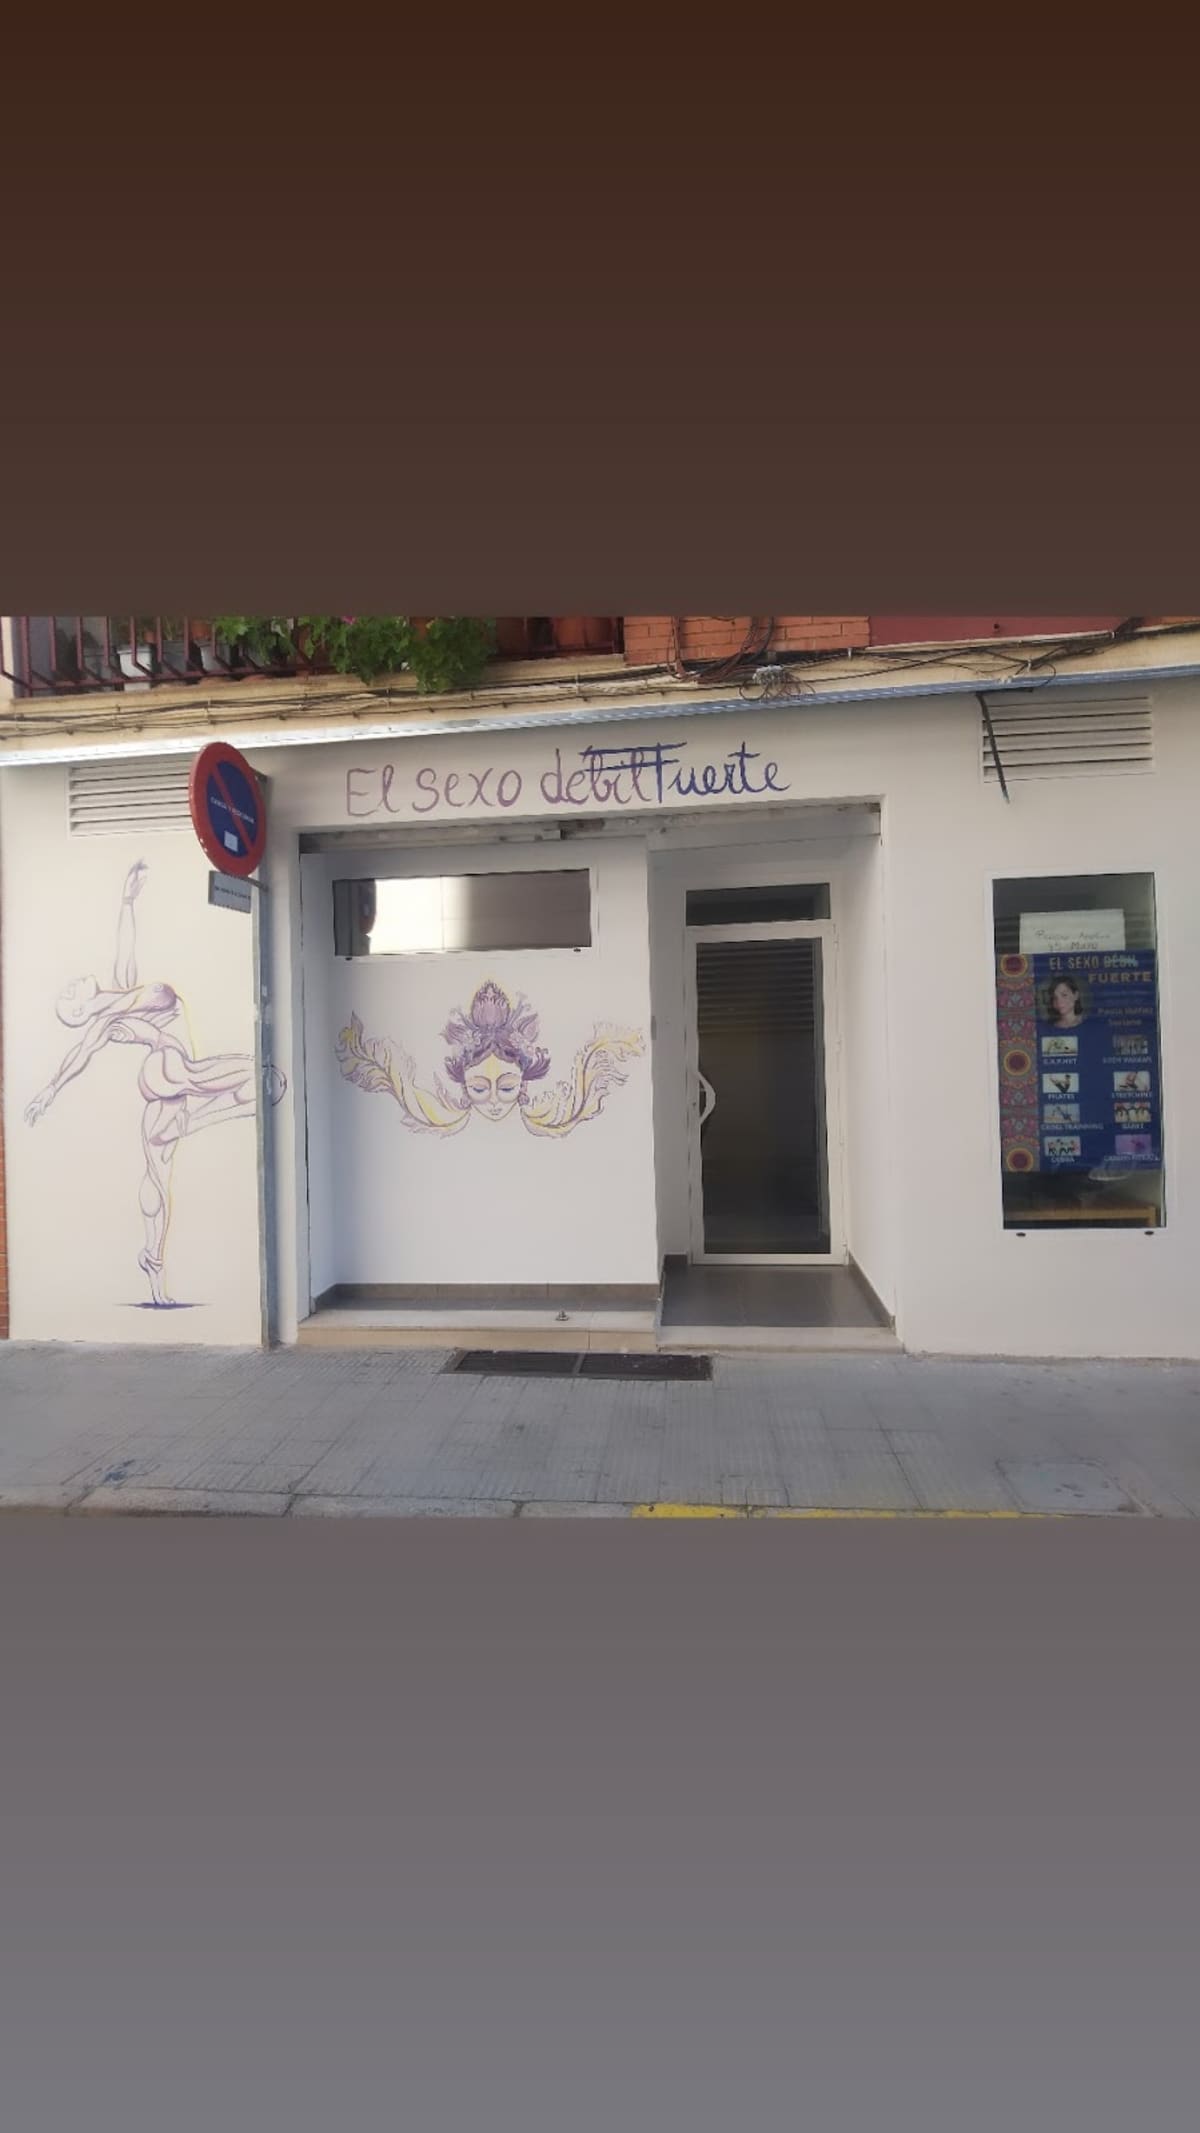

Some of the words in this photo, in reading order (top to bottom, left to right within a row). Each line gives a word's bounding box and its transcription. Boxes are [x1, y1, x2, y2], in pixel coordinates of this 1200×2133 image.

[346, 765, 400, 816] El
[411, 767, 523, 813] sexo
[1049, 958, 1064, 971] EL
[1068, 955, 1100, 969] SEXO
[1088, 971, 1152, 984] FUERTE
